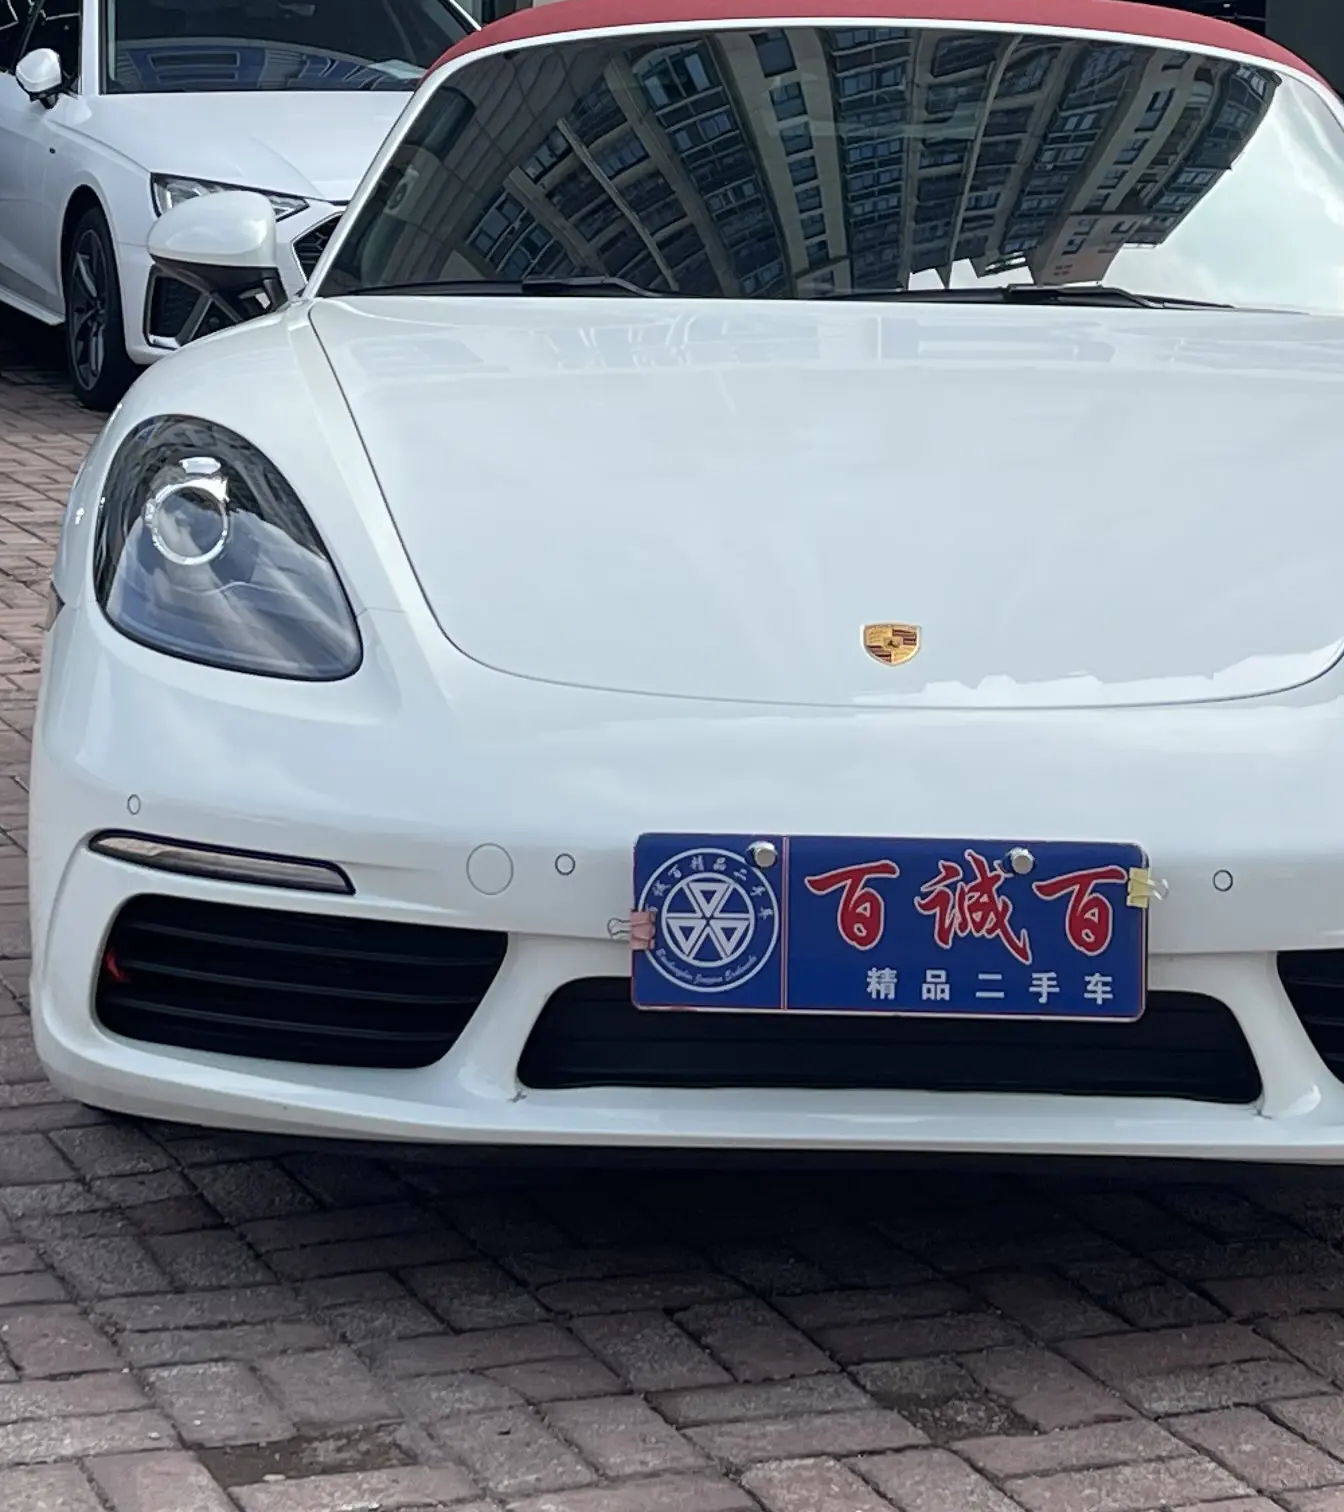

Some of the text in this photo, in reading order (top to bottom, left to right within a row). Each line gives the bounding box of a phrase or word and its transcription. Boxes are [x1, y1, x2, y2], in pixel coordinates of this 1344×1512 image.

[806, 850, 1130, 965] 百诚百
[866, 966, 1114, 1005] 精品二手车
